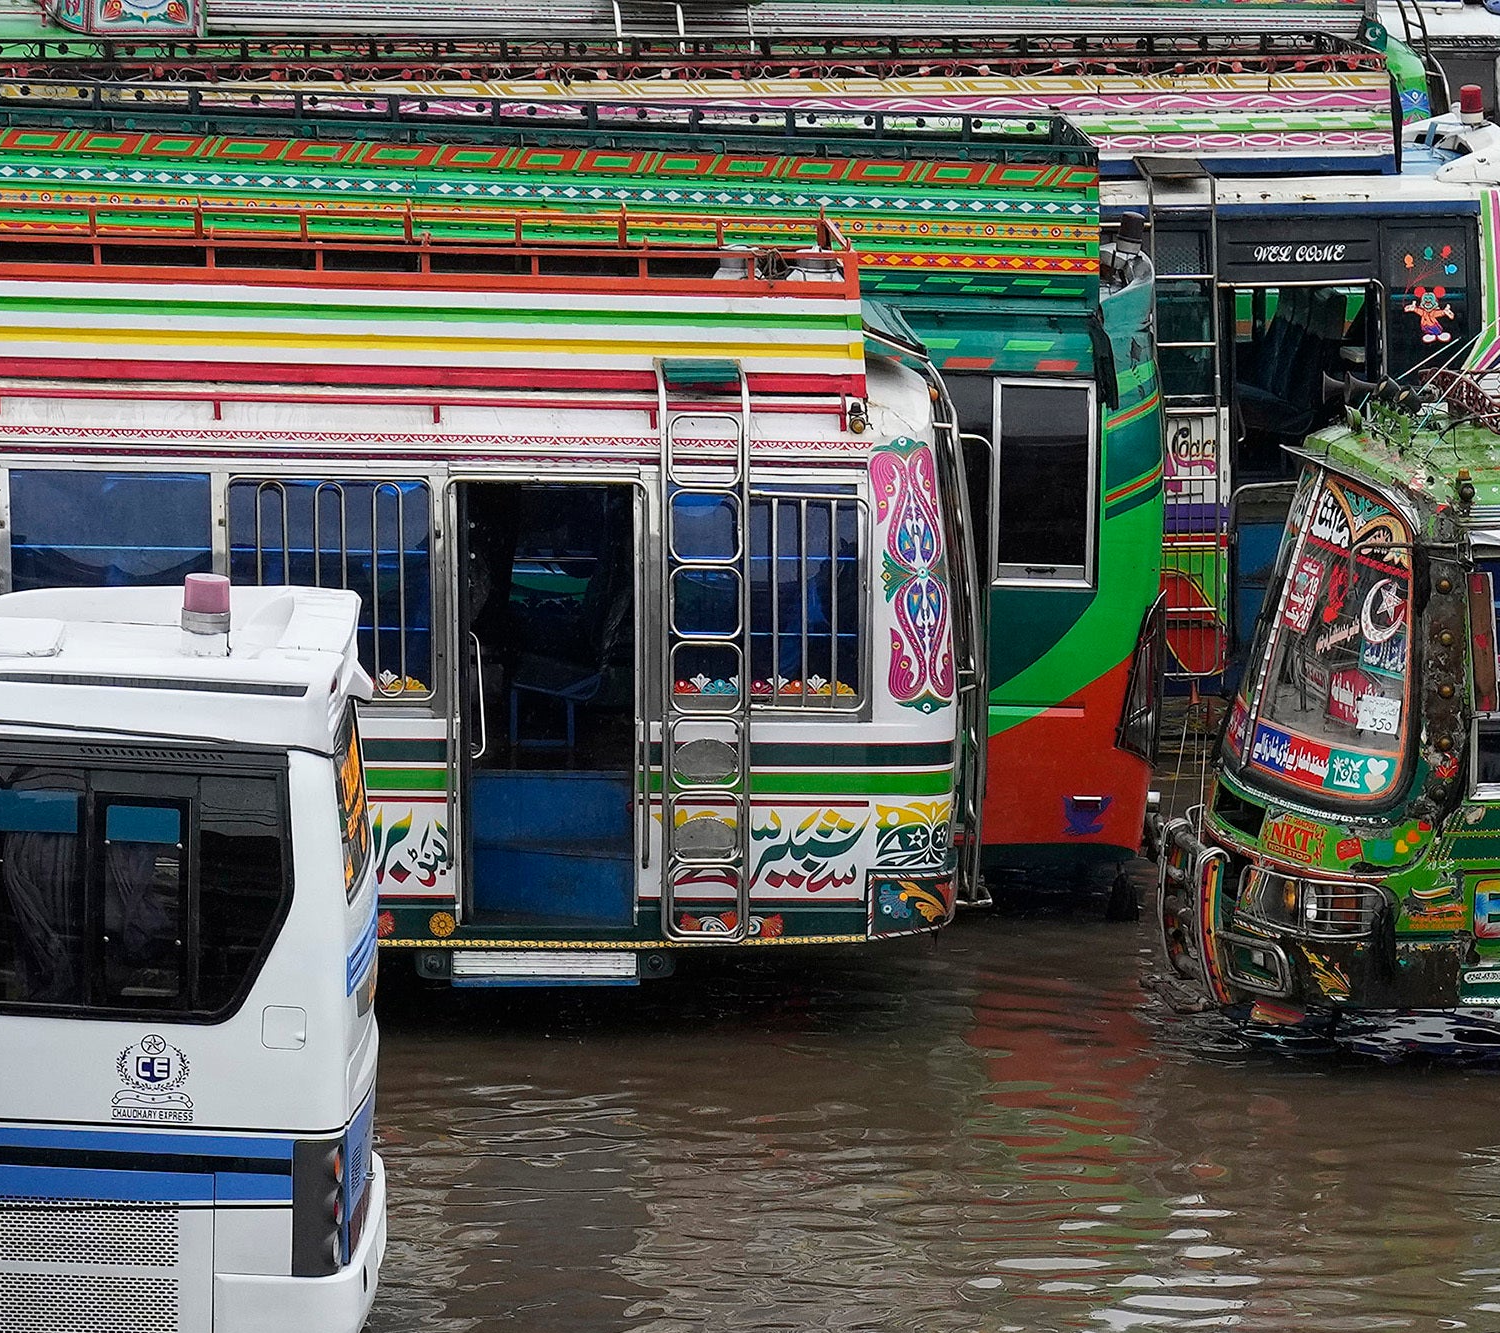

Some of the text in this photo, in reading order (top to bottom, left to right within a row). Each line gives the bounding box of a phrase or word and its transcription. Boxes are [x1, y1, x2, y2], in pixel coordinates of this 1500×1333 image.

[1271, 822, 1315, 852] NKT
[136, 1056, 170, 1083] CE
[111, 1108, 194, 1122] CHAUDHARY EXPRESS
